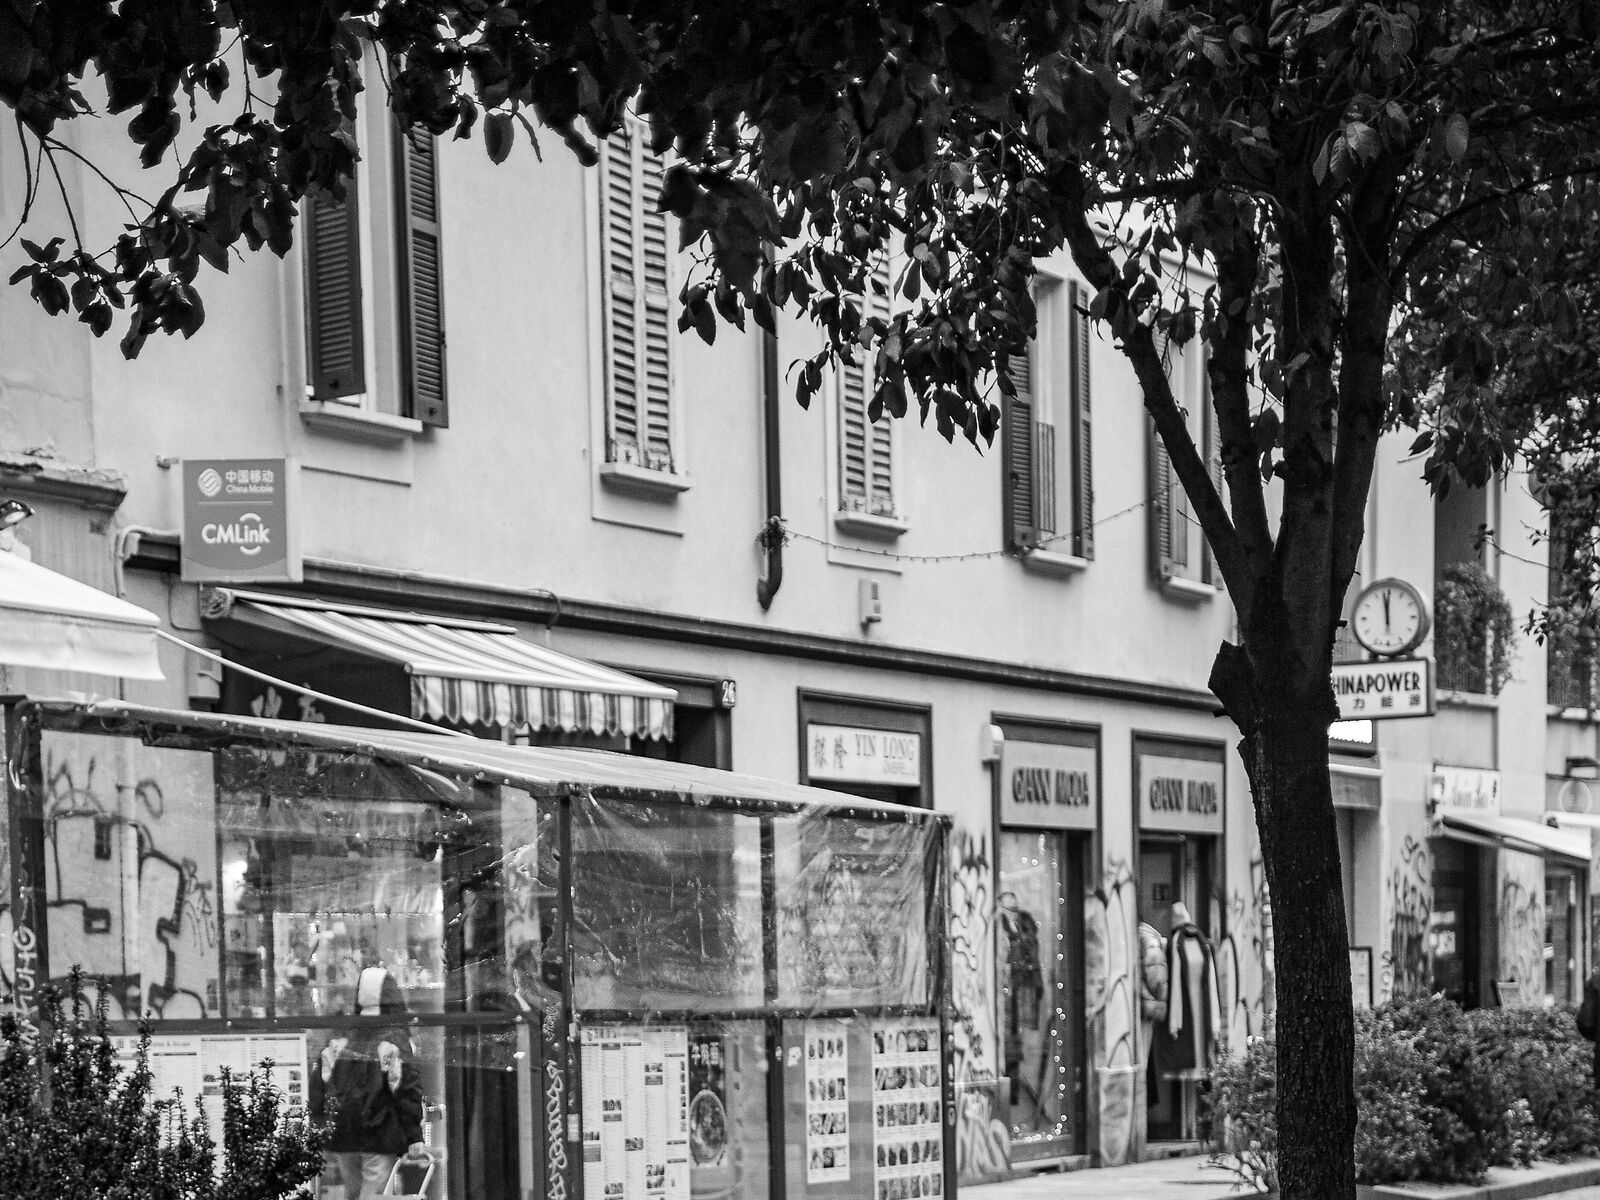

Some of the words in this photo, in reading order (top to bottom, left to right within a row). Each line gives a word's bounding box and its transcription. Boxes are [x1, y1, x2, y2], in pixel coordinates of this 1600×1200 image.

[225, 468, 274, 484] 中国移动
[225, 484, 248, 493] China
[249, 484, 274, 493] Mobile
[201, 521, 271, 545] CMLink
[722, 680, 736, 703] 26
[1332, 671, 1421, 696] HINAPOWER
[882, 736, 915, 761] LONG
